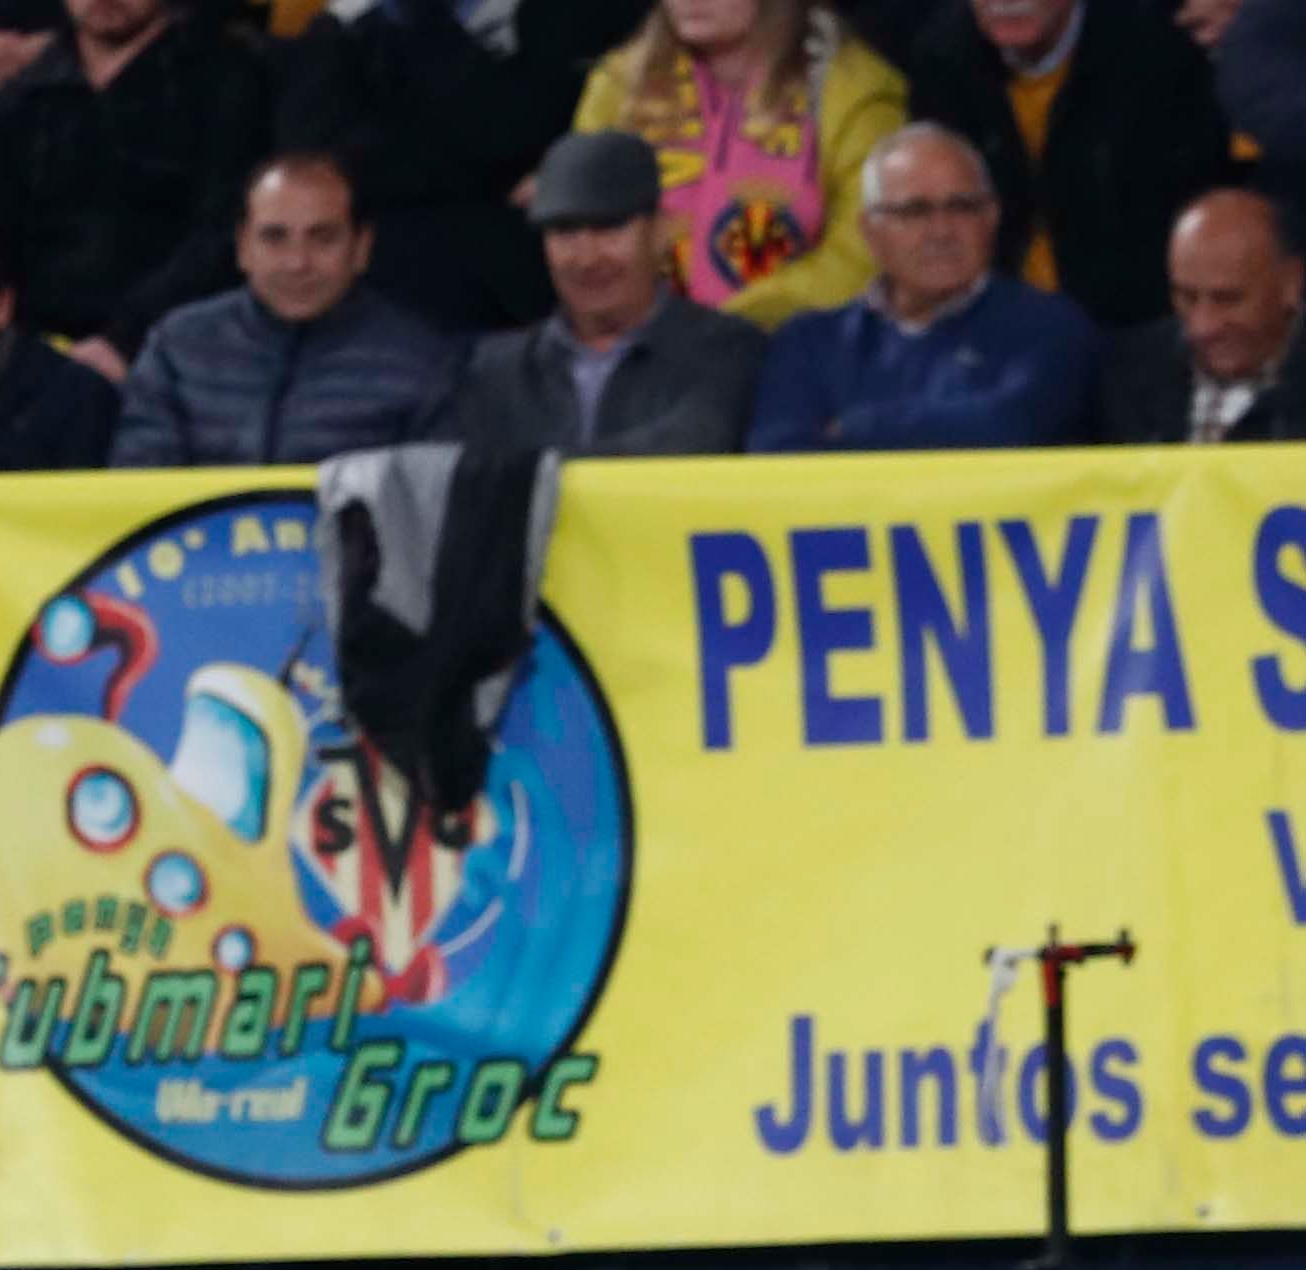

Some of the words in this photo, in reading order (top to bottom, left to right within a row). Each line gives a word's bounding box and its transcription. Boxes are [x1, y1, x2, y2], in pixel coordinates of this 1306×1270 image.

[689, 510, 1197, 752] PENYA
[321, 1040, 600, 1152] Groc
[753, 1013, 1144, 1158] Juntos
